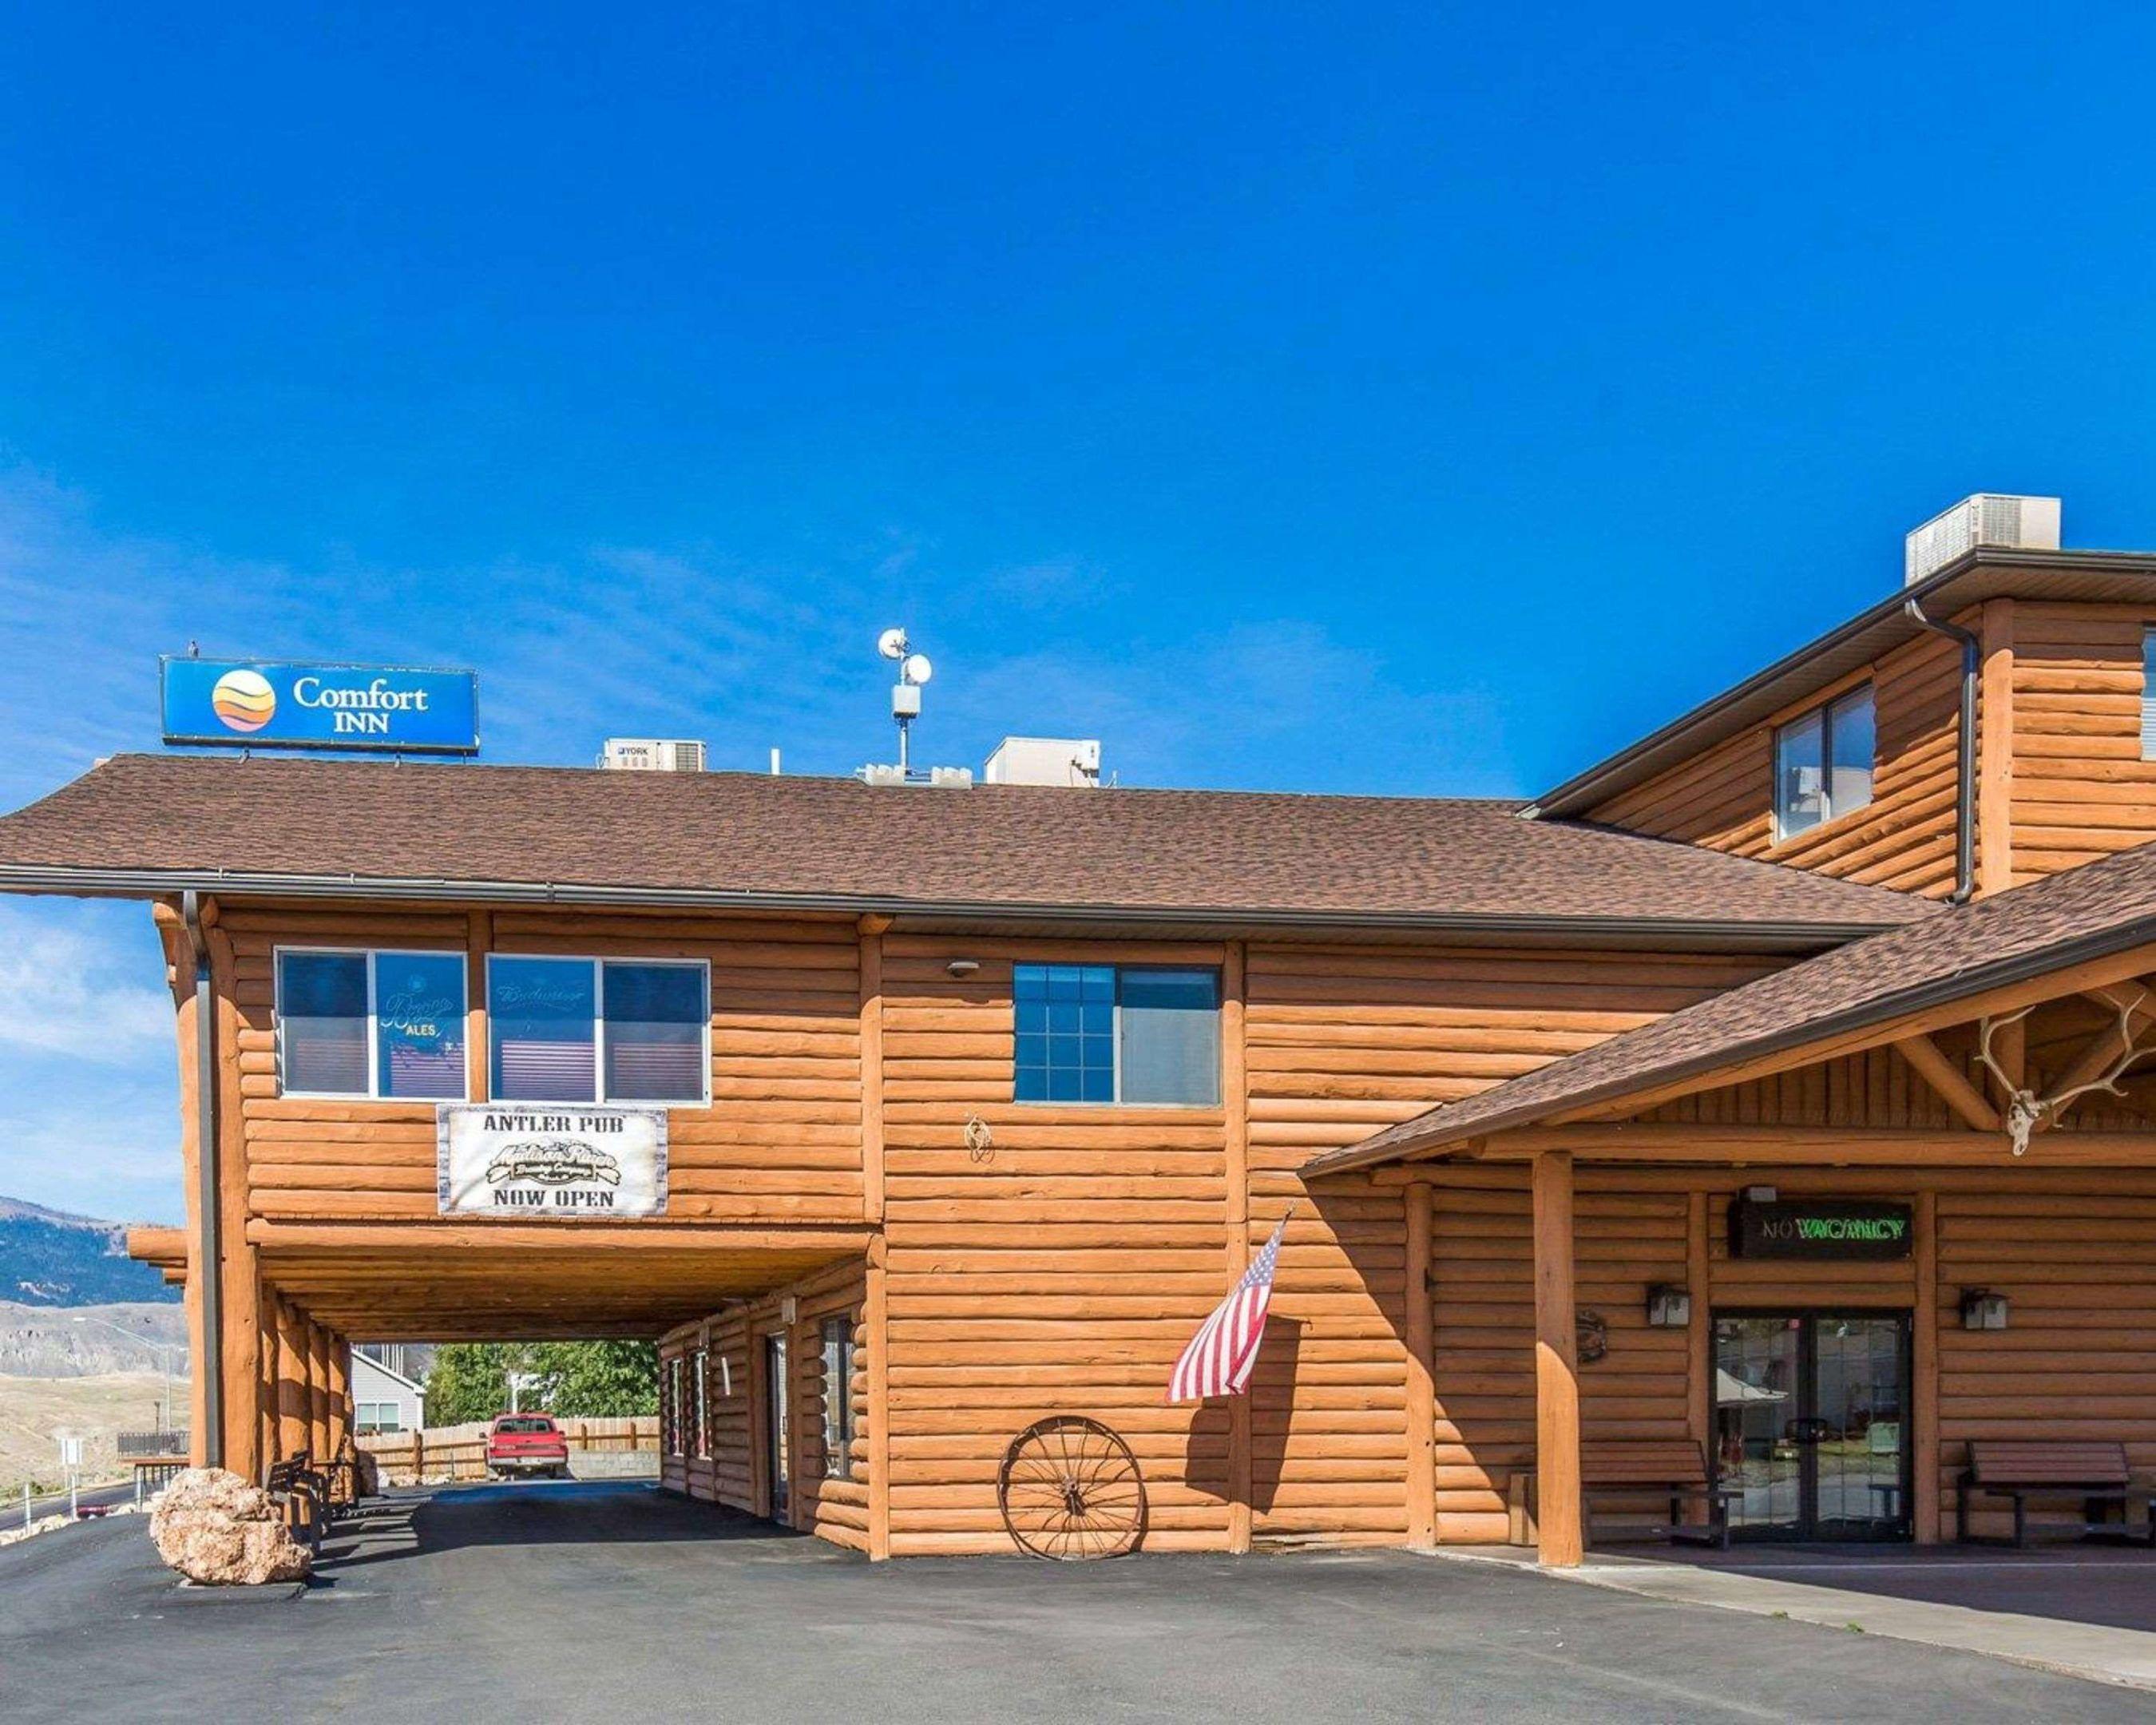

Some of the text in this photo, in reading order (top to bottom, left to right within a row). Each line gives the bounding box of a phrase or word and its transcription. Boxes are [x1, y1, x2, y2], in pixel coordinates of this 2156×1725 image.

[293, 676, 429, 711] Comfort
[334, 712, 390, 734] INN
[626, 747, 649, 755] YORK
[406, 1025, 436, 1036] ALES
[483, 1114, 624, 1133] ANTLER PUB
[493, 1189, 614, 1207] NOW OPEN
[1762, 1217, 1905, 1239] NO VACANCY
